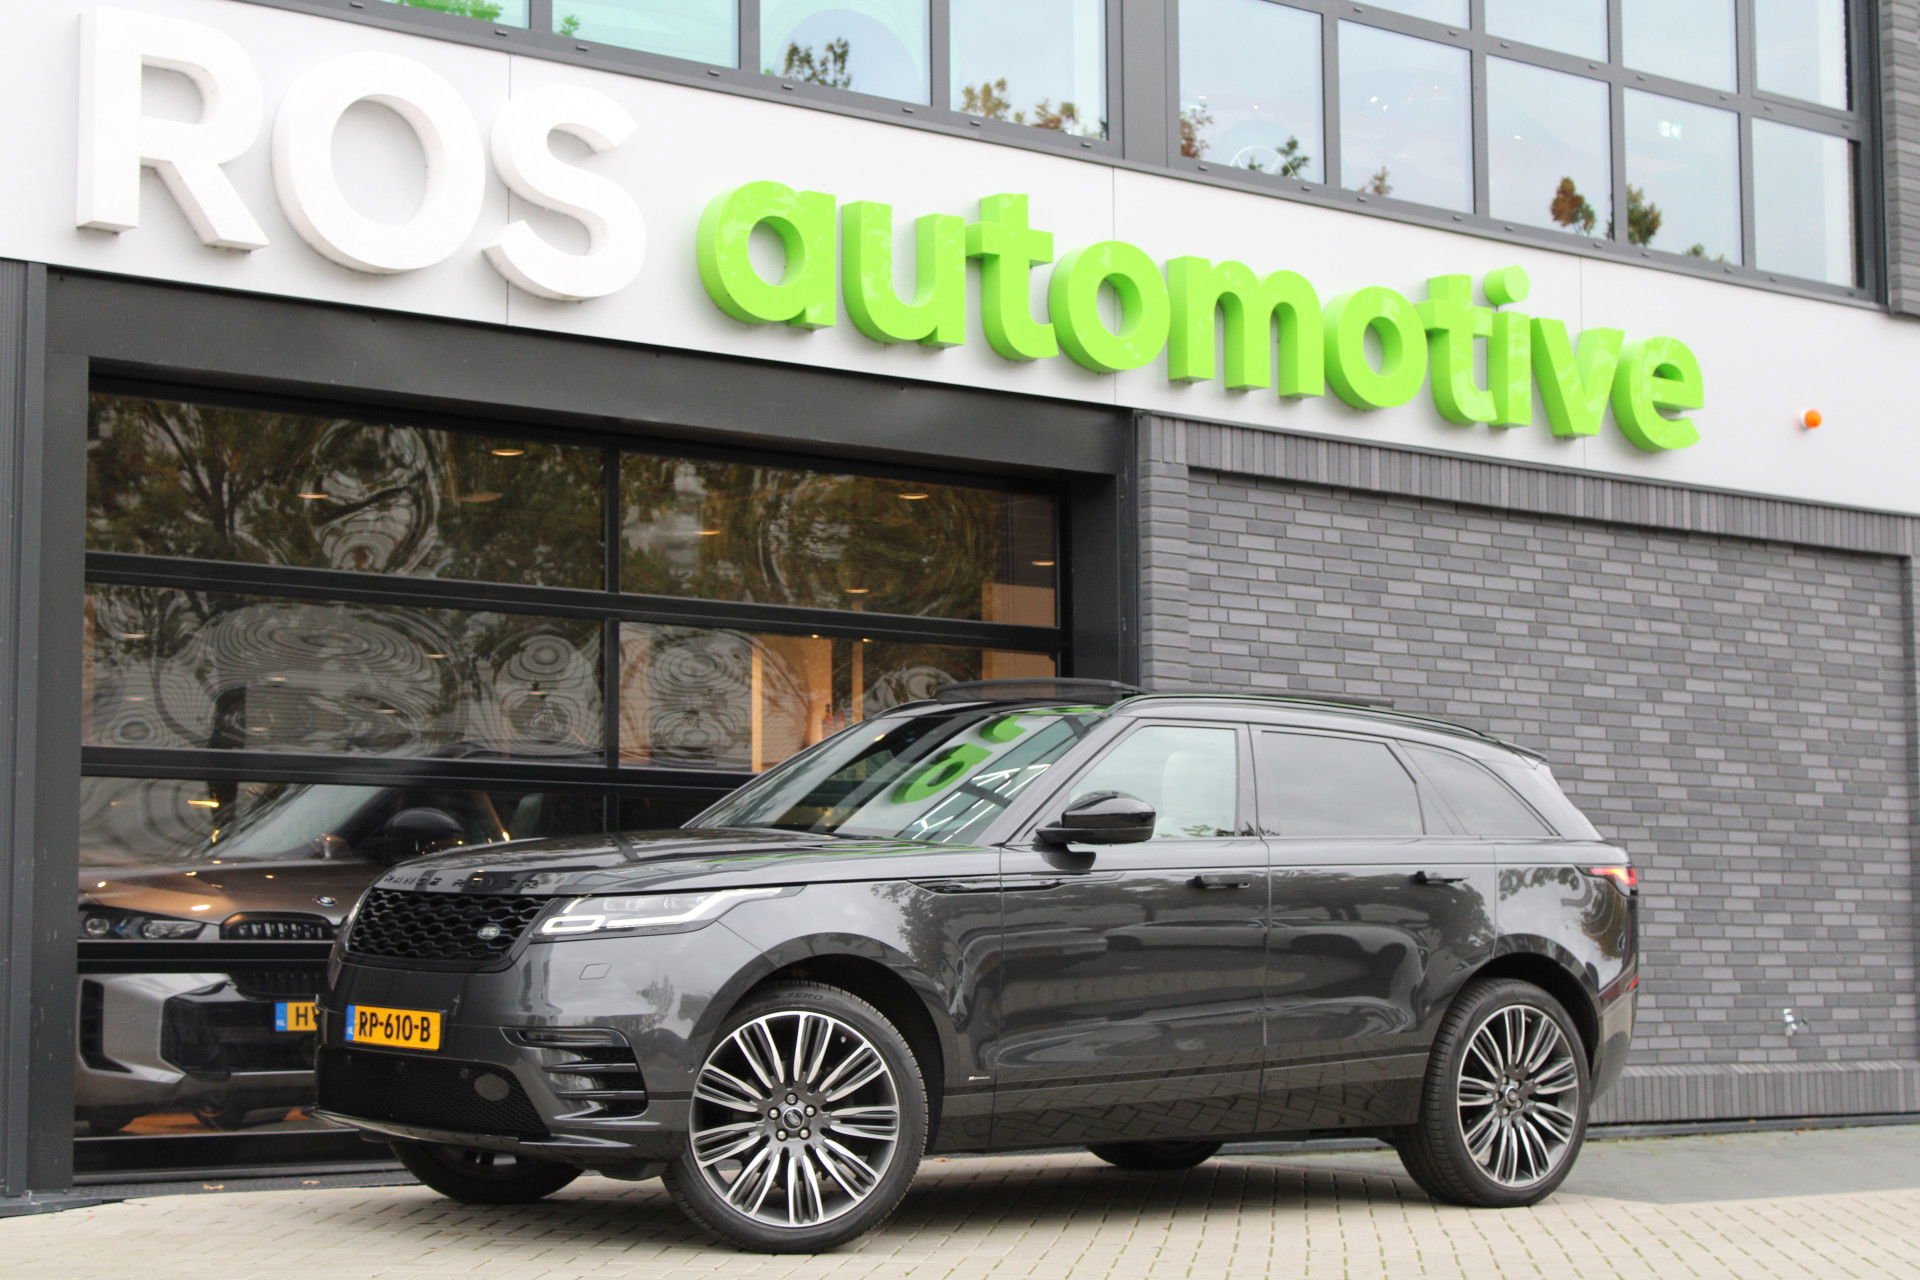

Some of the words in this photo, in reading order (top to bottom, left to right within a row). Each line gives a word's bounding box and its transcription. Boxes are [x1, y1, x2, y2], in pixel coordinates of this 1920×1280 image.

[77, 8, 646, 302] ROS
[696, 181, 1703, 452] automotive
[358, 1011, 431, 1043] RP-610-B
